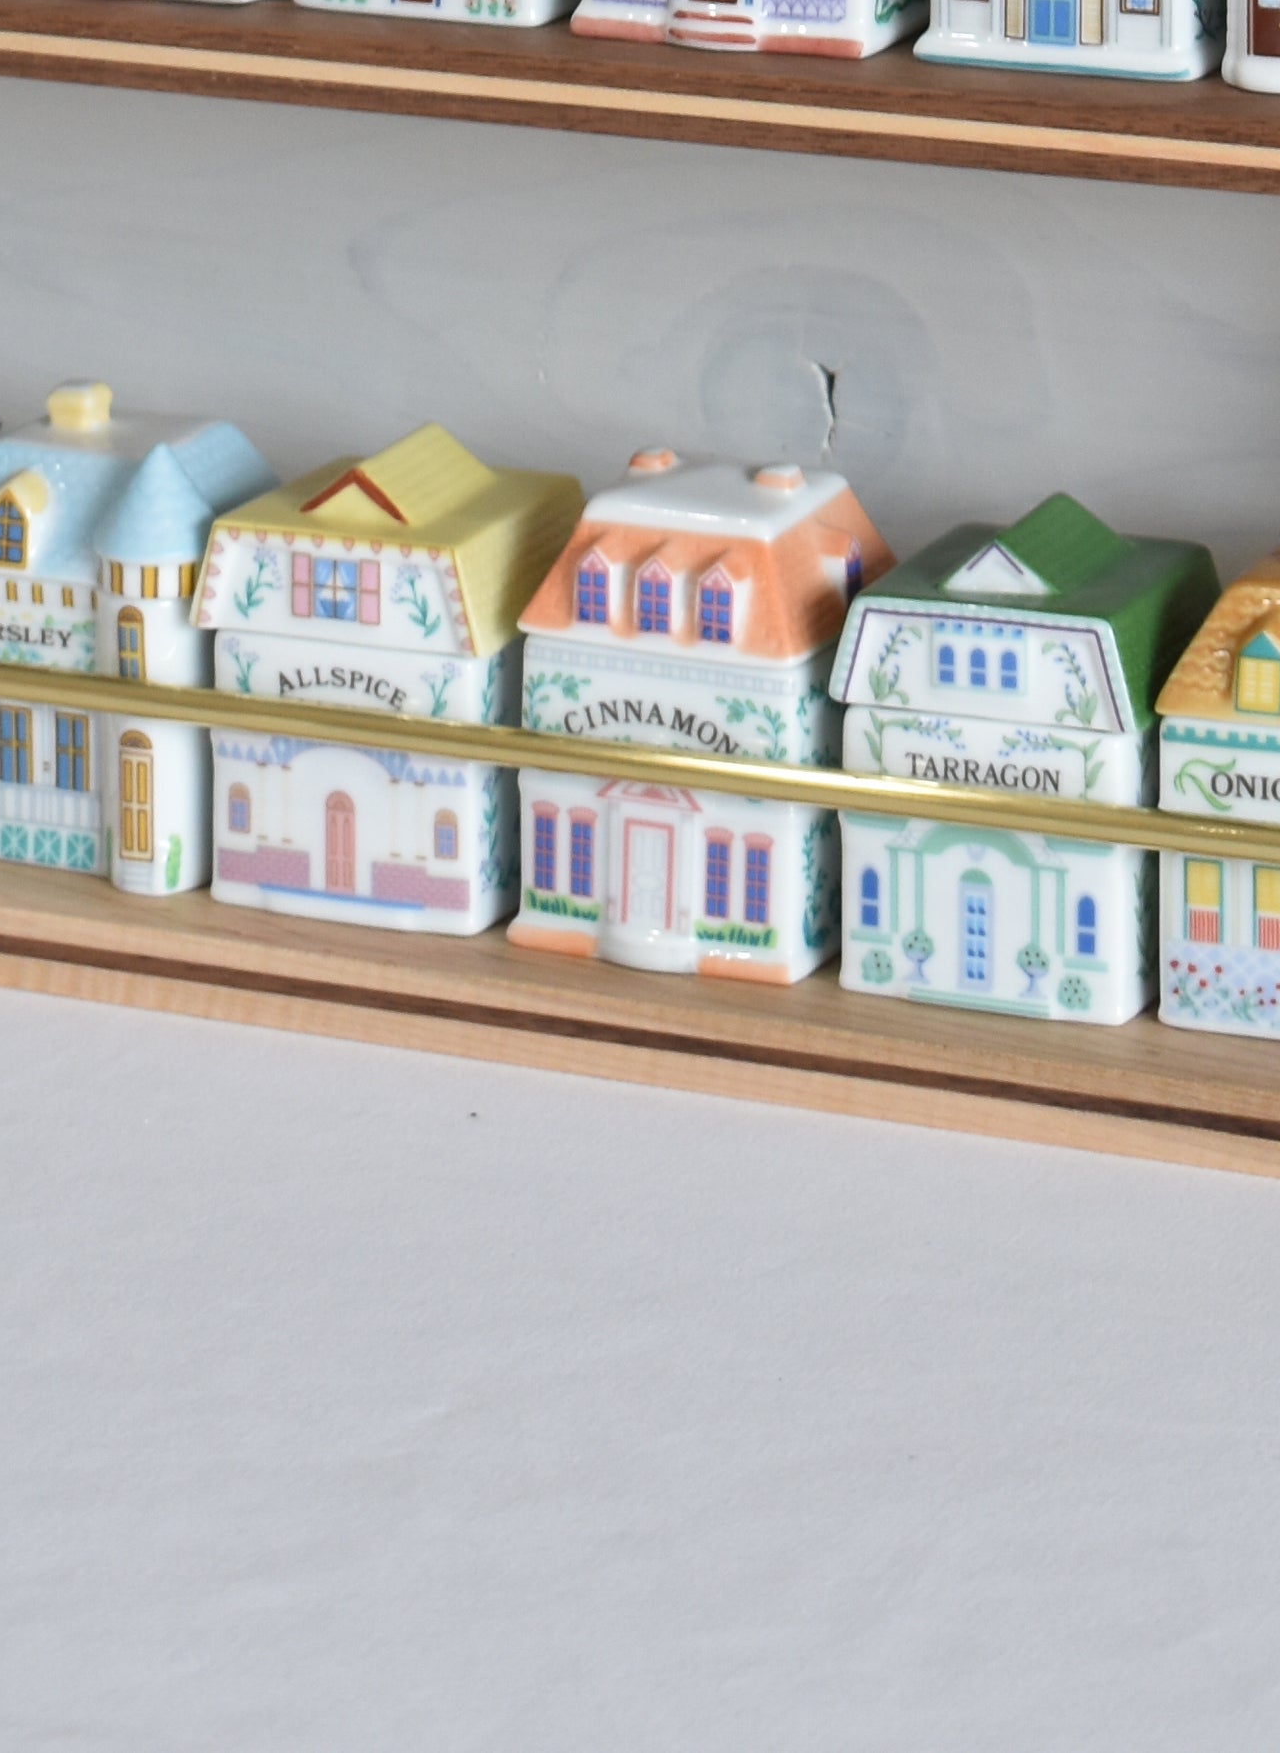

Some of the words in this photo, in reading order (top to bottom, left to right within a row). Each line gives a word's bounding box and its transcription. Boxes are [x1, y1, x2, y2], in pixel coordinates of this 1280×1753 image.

[277, 666, 408, 712] ALLSPICE
[563, 699, 740, 755] CINNAMON
[905, 751, 1061, 792] TARRAGON
